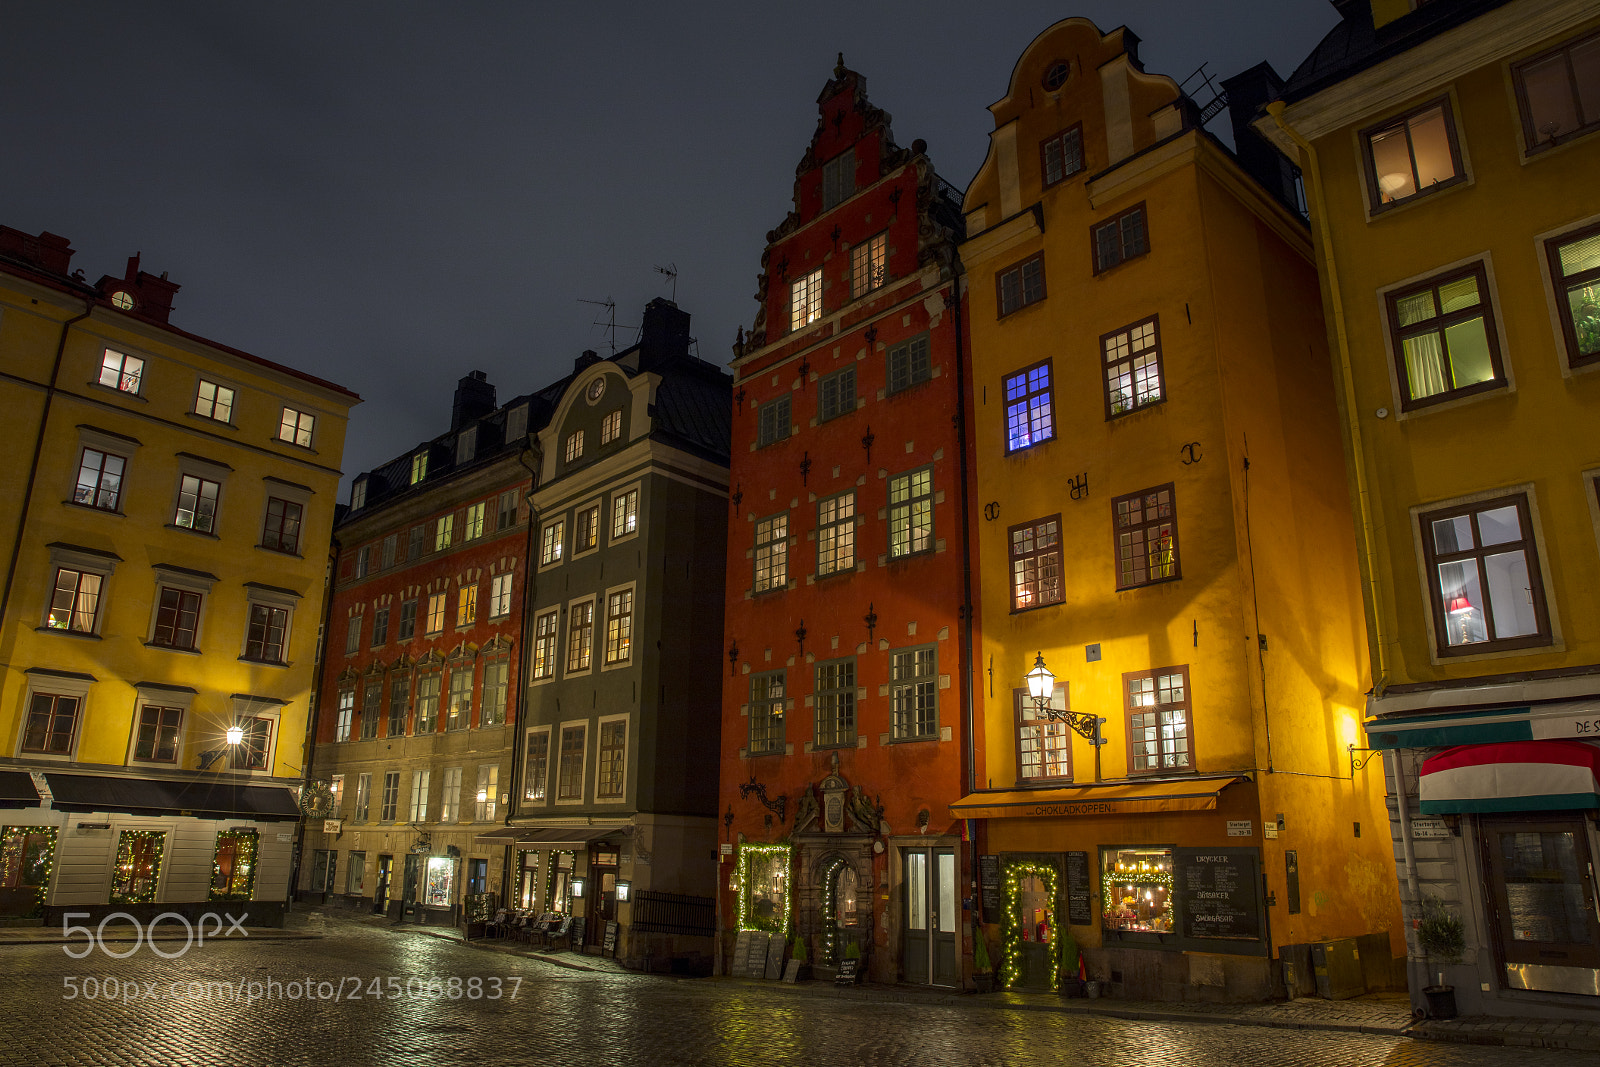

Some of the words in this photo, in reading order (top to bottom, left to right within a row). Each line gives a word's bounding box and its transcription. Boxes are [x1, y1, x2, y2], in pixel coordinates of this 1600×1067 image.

[1575, 721, 1591, 734] DE
[1594, 720, 1600, 733] S
[1035, 803, 1111, 815] CHOKLADKOPPEN
